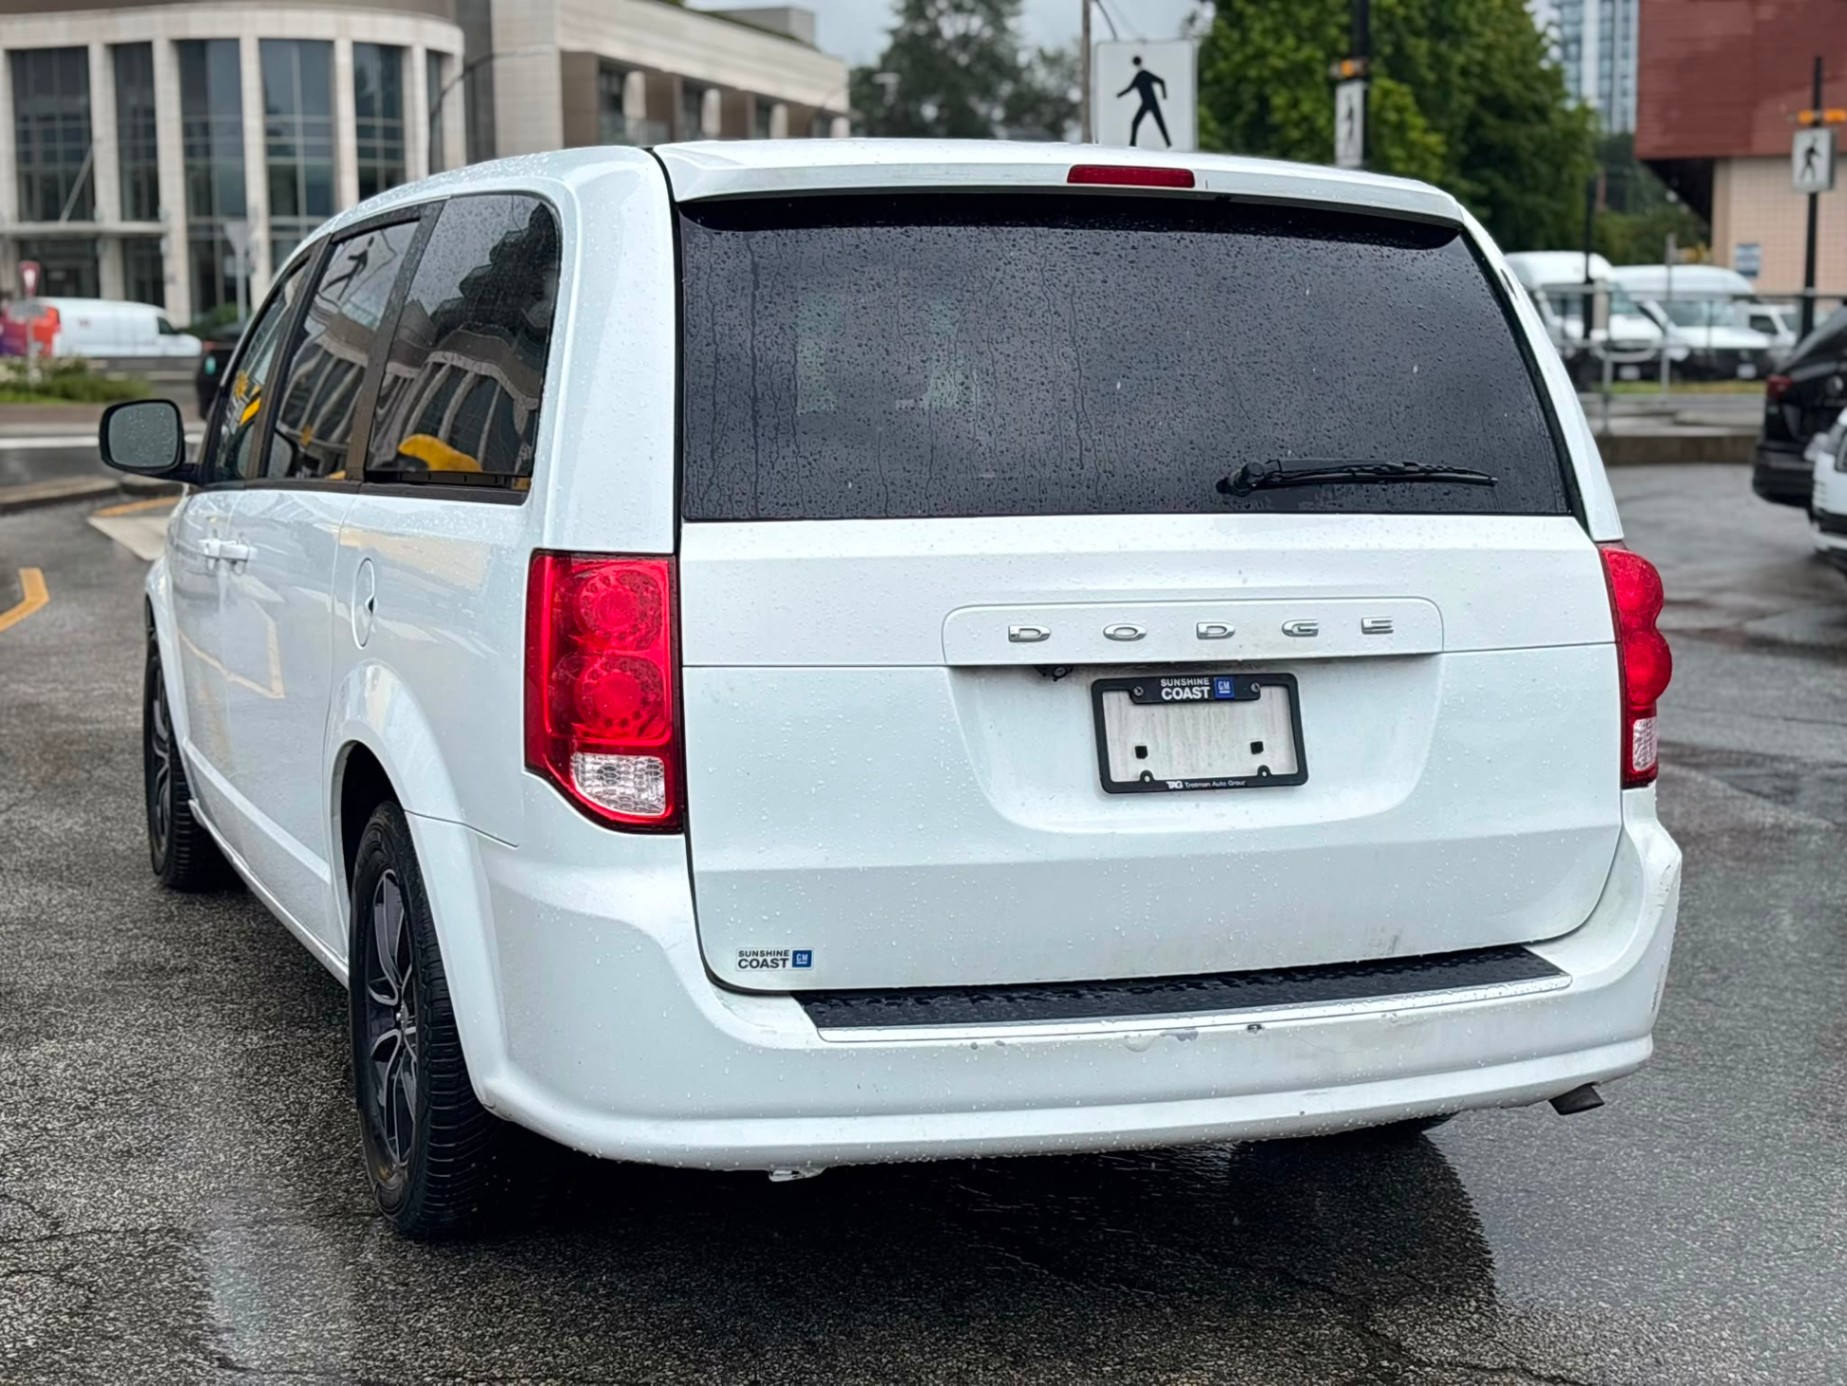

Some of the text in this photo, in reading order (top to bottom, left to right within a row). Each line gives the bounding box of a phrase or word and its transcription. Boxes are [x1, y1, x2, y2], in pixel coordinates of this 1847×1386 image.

[1008, 616, 1394, 643] DODGE
[1160, 678, 1210, 687] SUNSHINE
[1218, 681, 1230, 690] GM
[1161, 687, 1210, 700] COAST
[738, 949, 790, 958] SUNSHINE
[738, 958, 789, 969] COAST
